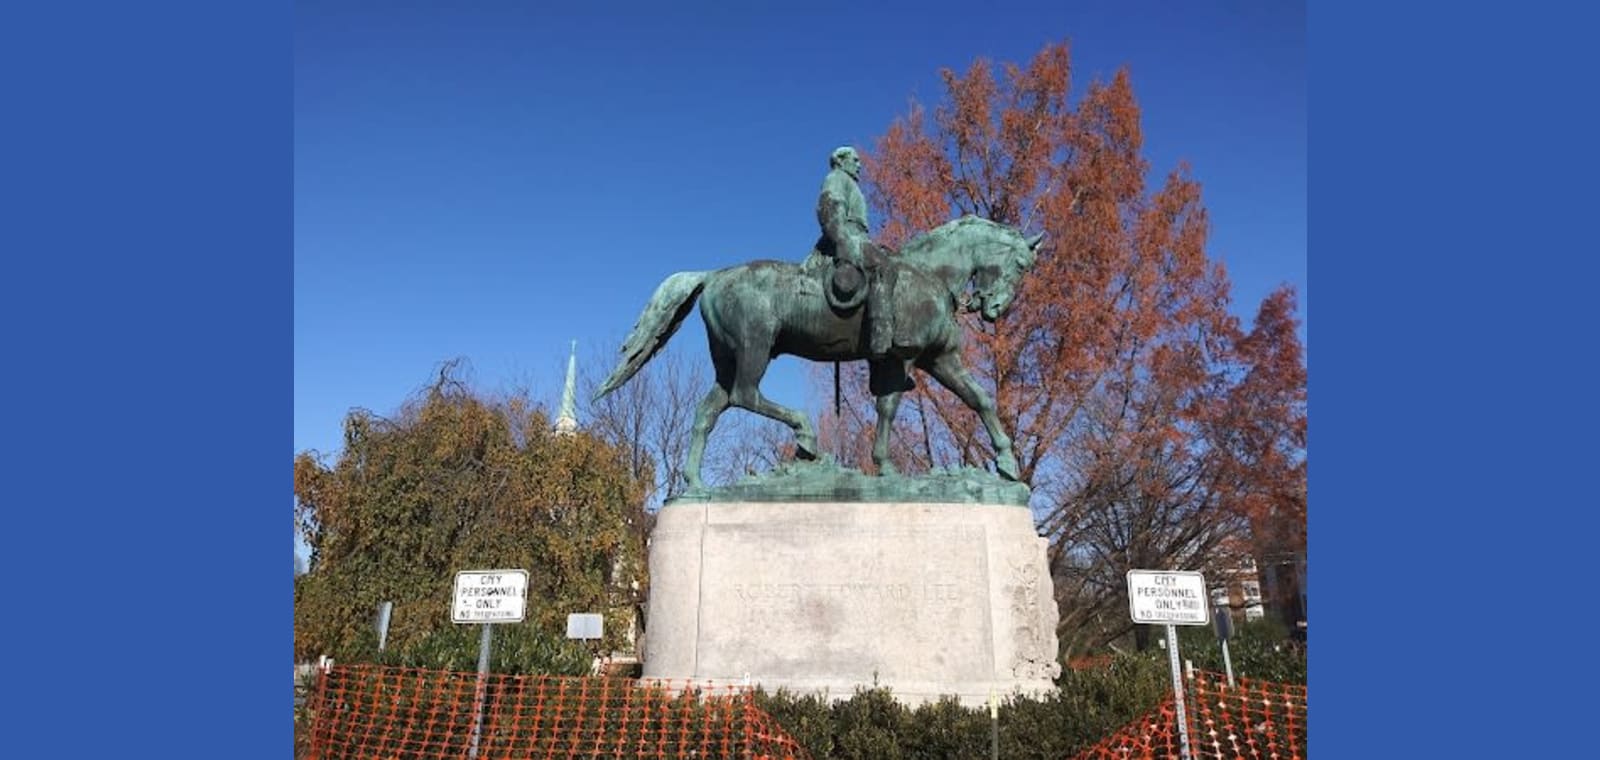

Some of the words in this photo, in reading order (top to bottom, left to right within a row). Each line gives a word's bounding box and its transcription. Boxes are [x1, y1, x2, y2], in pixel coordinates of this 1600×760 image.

[461, 586, 517, 597] PERSONNEL
[1137, 587, 1198, 599] PERSONNEL
[476, 600, 502, 609] ONLY
[1155, 600, 1182, 610] ONLY
